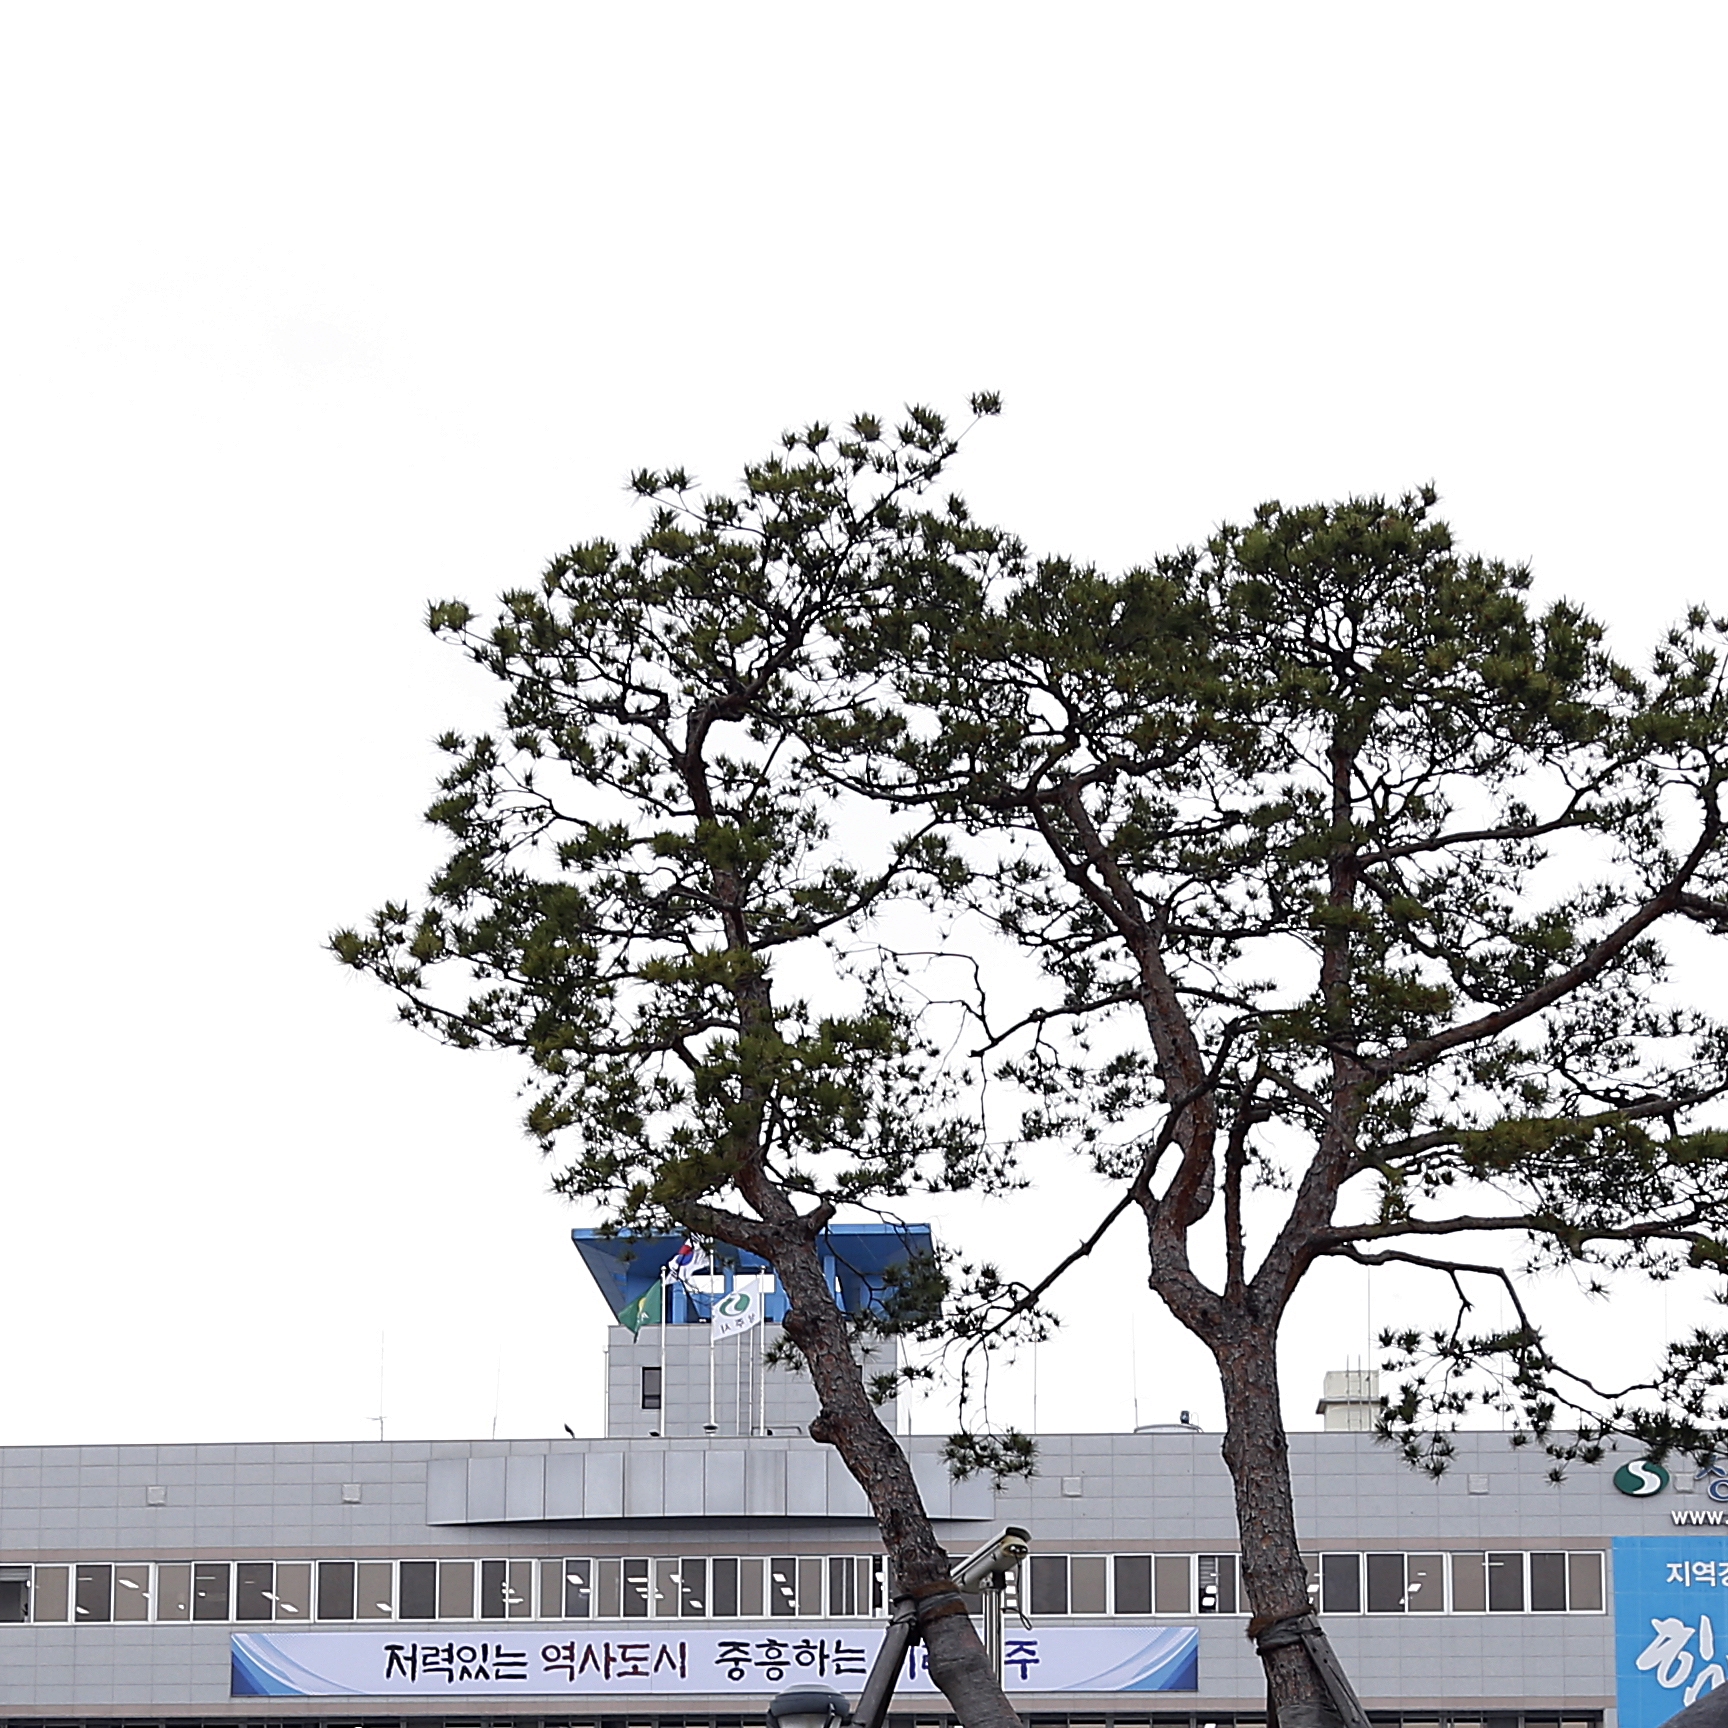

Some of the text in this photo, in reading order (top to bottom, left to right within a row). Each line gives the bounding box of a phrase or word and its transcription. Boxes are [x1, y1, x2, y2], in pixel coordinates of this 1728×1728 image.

[383, 1640, 530, 1684] 저력있는
[540, 1640, 688, 1684] 역사도시
[713, 1639, 868, 1683] 중흥하는
